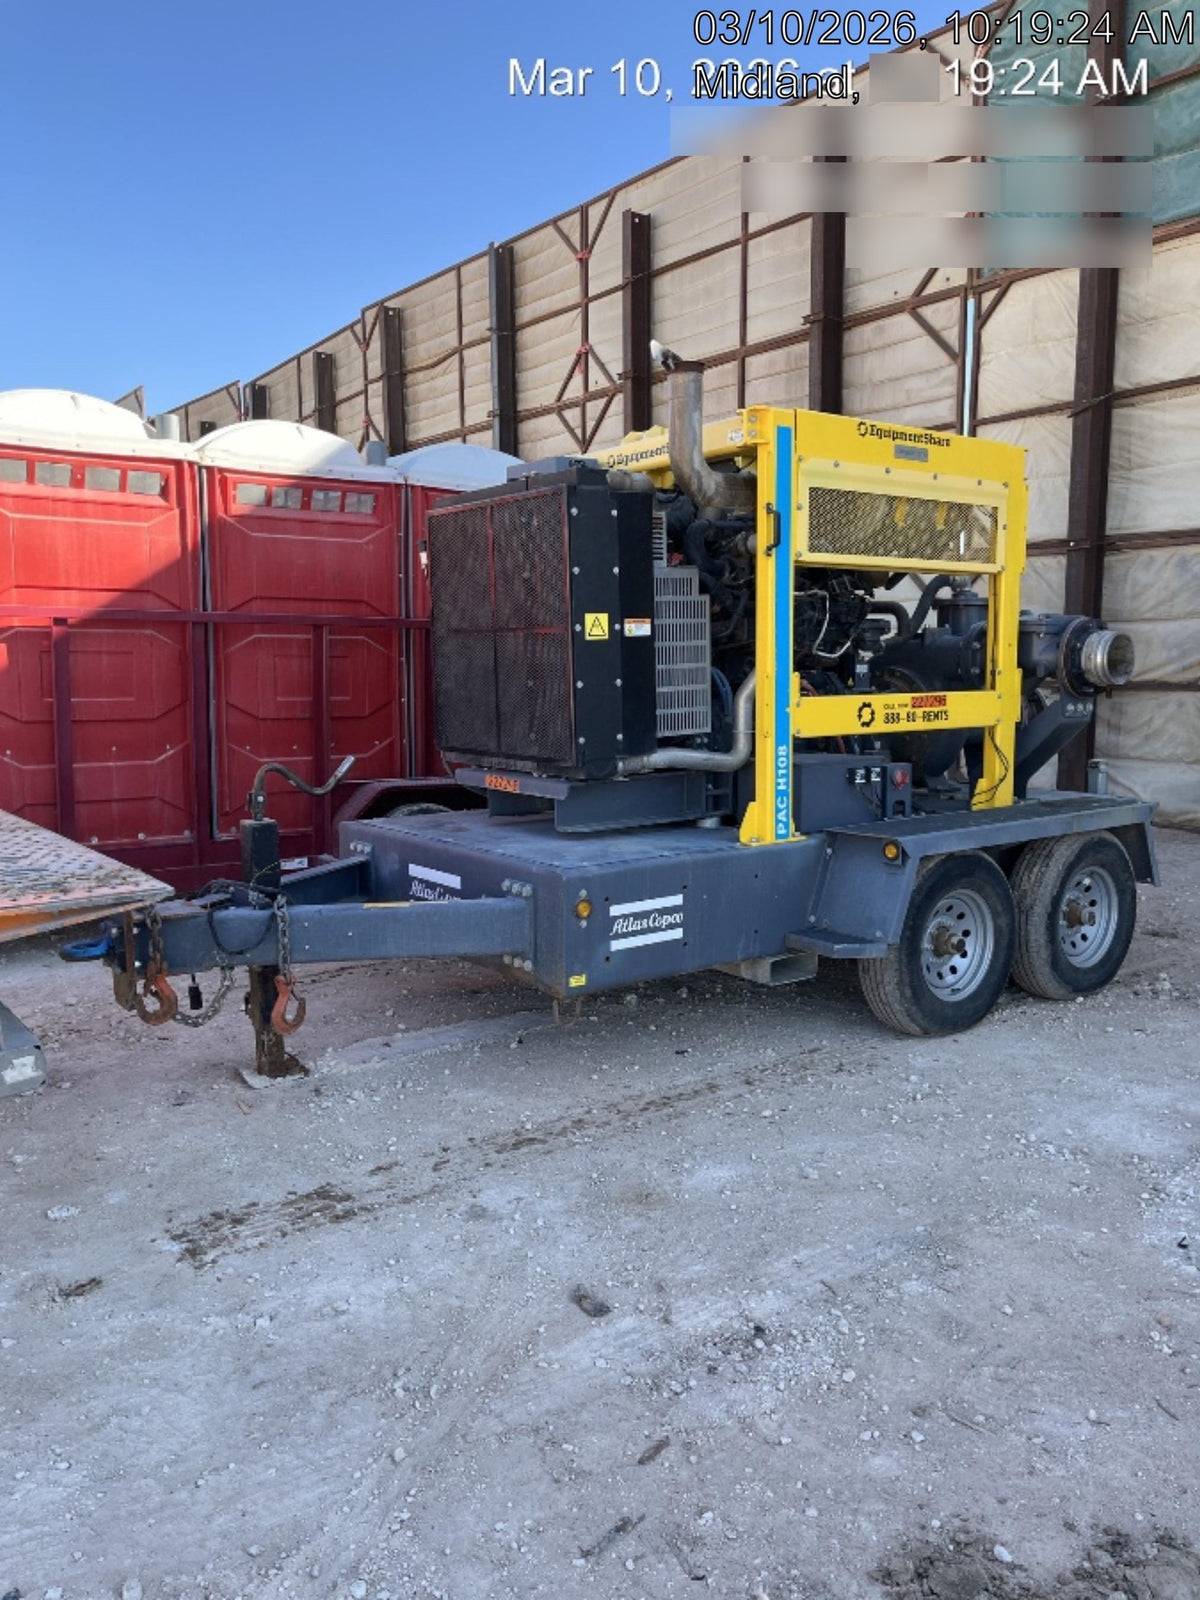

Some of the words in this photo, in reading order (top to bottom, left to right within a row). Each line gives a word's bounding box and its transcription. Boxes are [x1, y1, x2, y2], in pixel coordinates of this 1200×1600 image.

[869, 424, 950, 447] EquipmentShare
[777, 745, 788, 790] H108
[777, 795, 788, 834] PAC
[609, 917, 648, 936] Atlas
[648, 911, 684, 929] Copco
